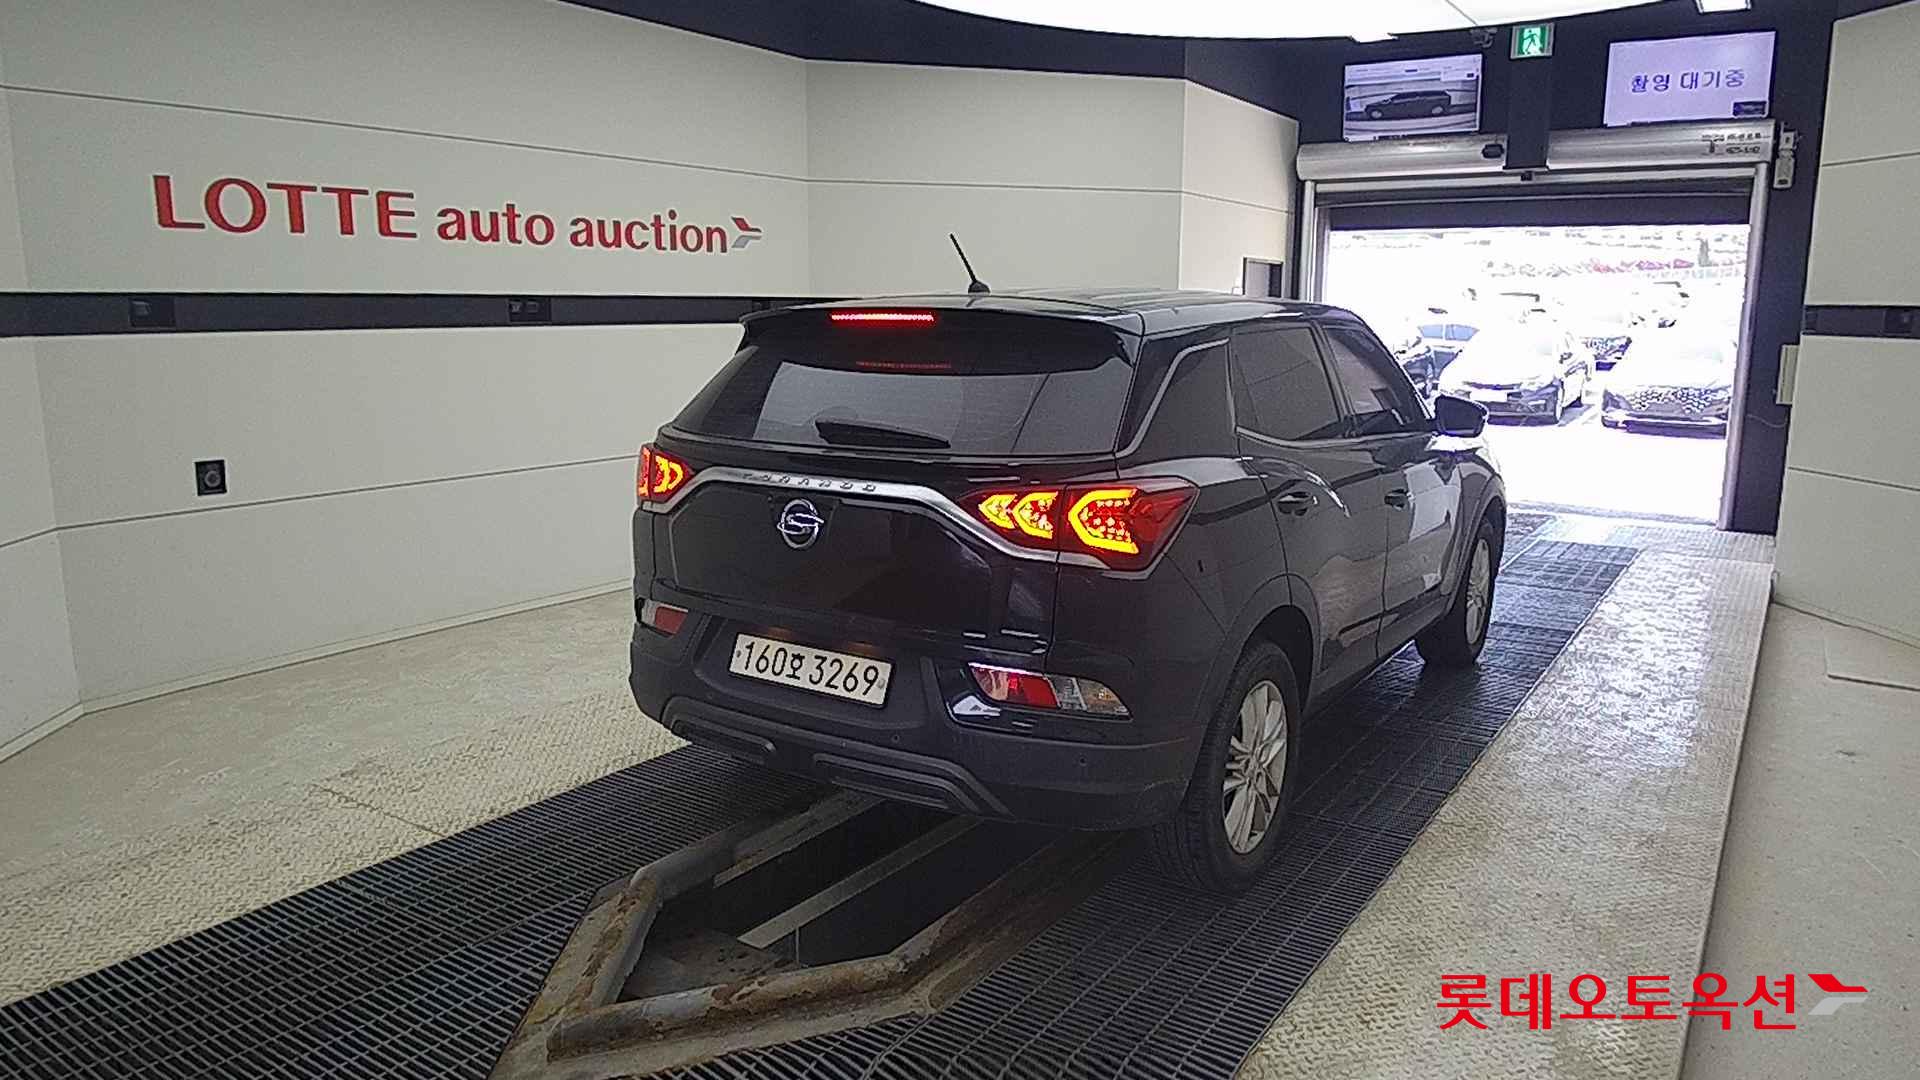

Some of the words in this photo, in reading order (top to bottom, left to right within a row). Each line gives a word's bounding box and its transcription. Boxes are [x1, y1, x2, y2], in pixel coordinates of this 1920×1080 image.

[1630, 72, 1671, 94] 촬영
[1679, 68, 1745, 91] 대기중
[153, 174, 418, 240] LOTTE
[437, 202, 555, 247] auto
[569, 209, 729, 254] auction
